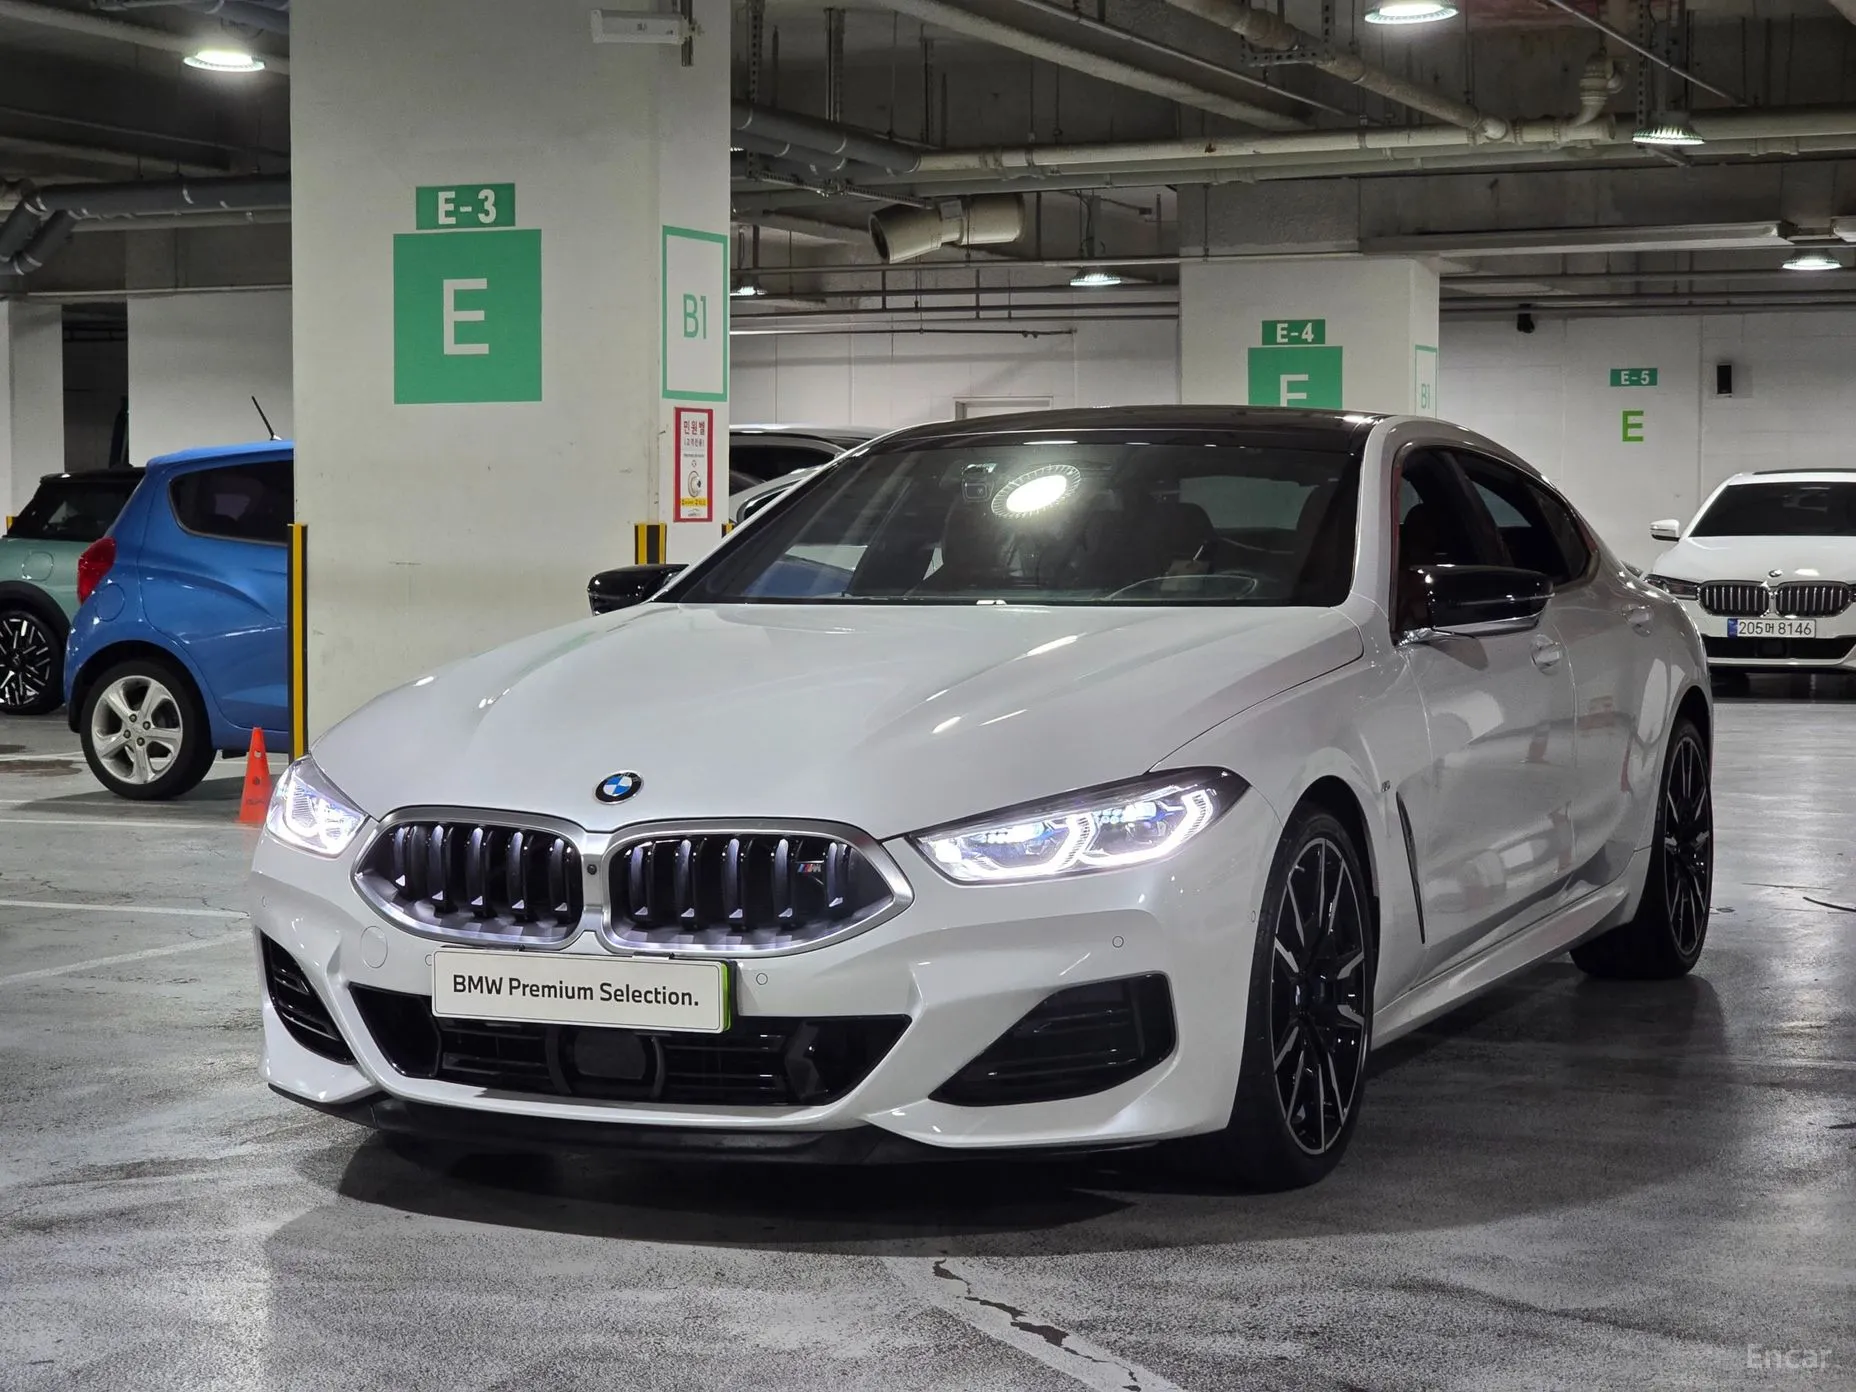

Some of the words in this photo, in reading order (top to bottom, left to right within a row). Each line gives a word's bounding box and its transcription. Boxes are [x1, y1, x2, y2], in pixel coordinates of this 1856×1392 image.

[438, 188, 497, 225] E-3
[443, 278, 489, 355] E
[683, 293, 707, 340] B1
[1276, 322, 1314, 343] E-4
[1620, 370, 1650, 385] E-5
[1420, 383, 1430, 409] B1
[1622, 410, 1644, 442] E
[1778, 622, 1812, 636] 8146
[453, 974, 503, 995] BMW
[508, 977, 594, 1001] Premium
[599, 982, 700, 1007] Selection.
